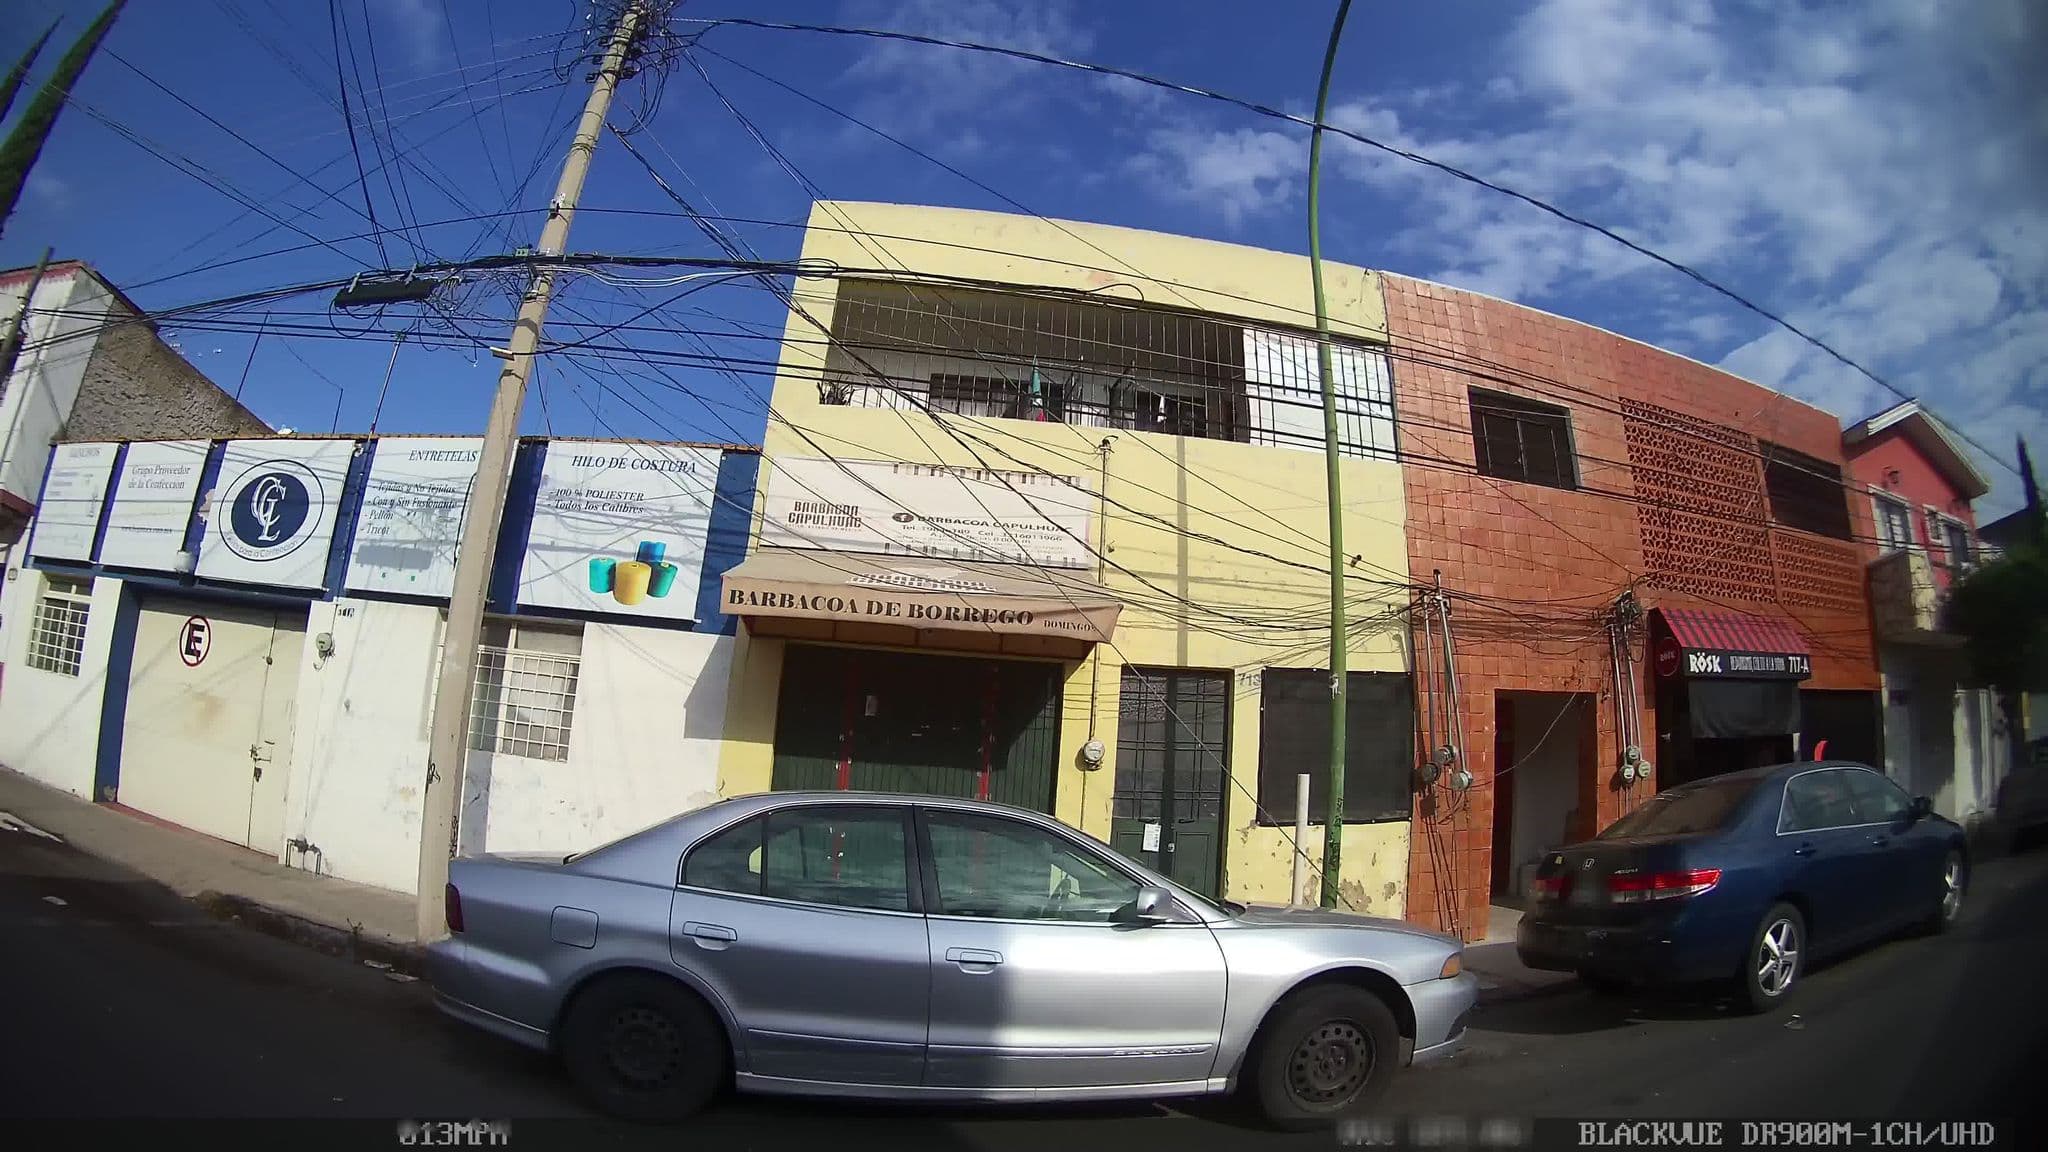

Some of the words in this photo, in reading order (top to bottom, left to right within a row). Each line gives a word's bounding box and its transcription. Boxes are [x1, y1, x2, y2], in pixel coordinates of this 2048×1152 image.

[409, 450, 478, 461] ENTRETELAS
[572, 455, 606, 468] HILO
[608, 457, 629, 469] DE
[631, 458, 697, 473] COSTURA
[585, 488, 645, 501] POLIESTER
[794, 501, 859, 516] BARBACOA
[729, 589, 859, 614] BARBACOA
[866, 599, 901, 617] DE
[907, 603, 1034, 625] BORREGO
[1689, 652, 1722, 673] RÖSK
